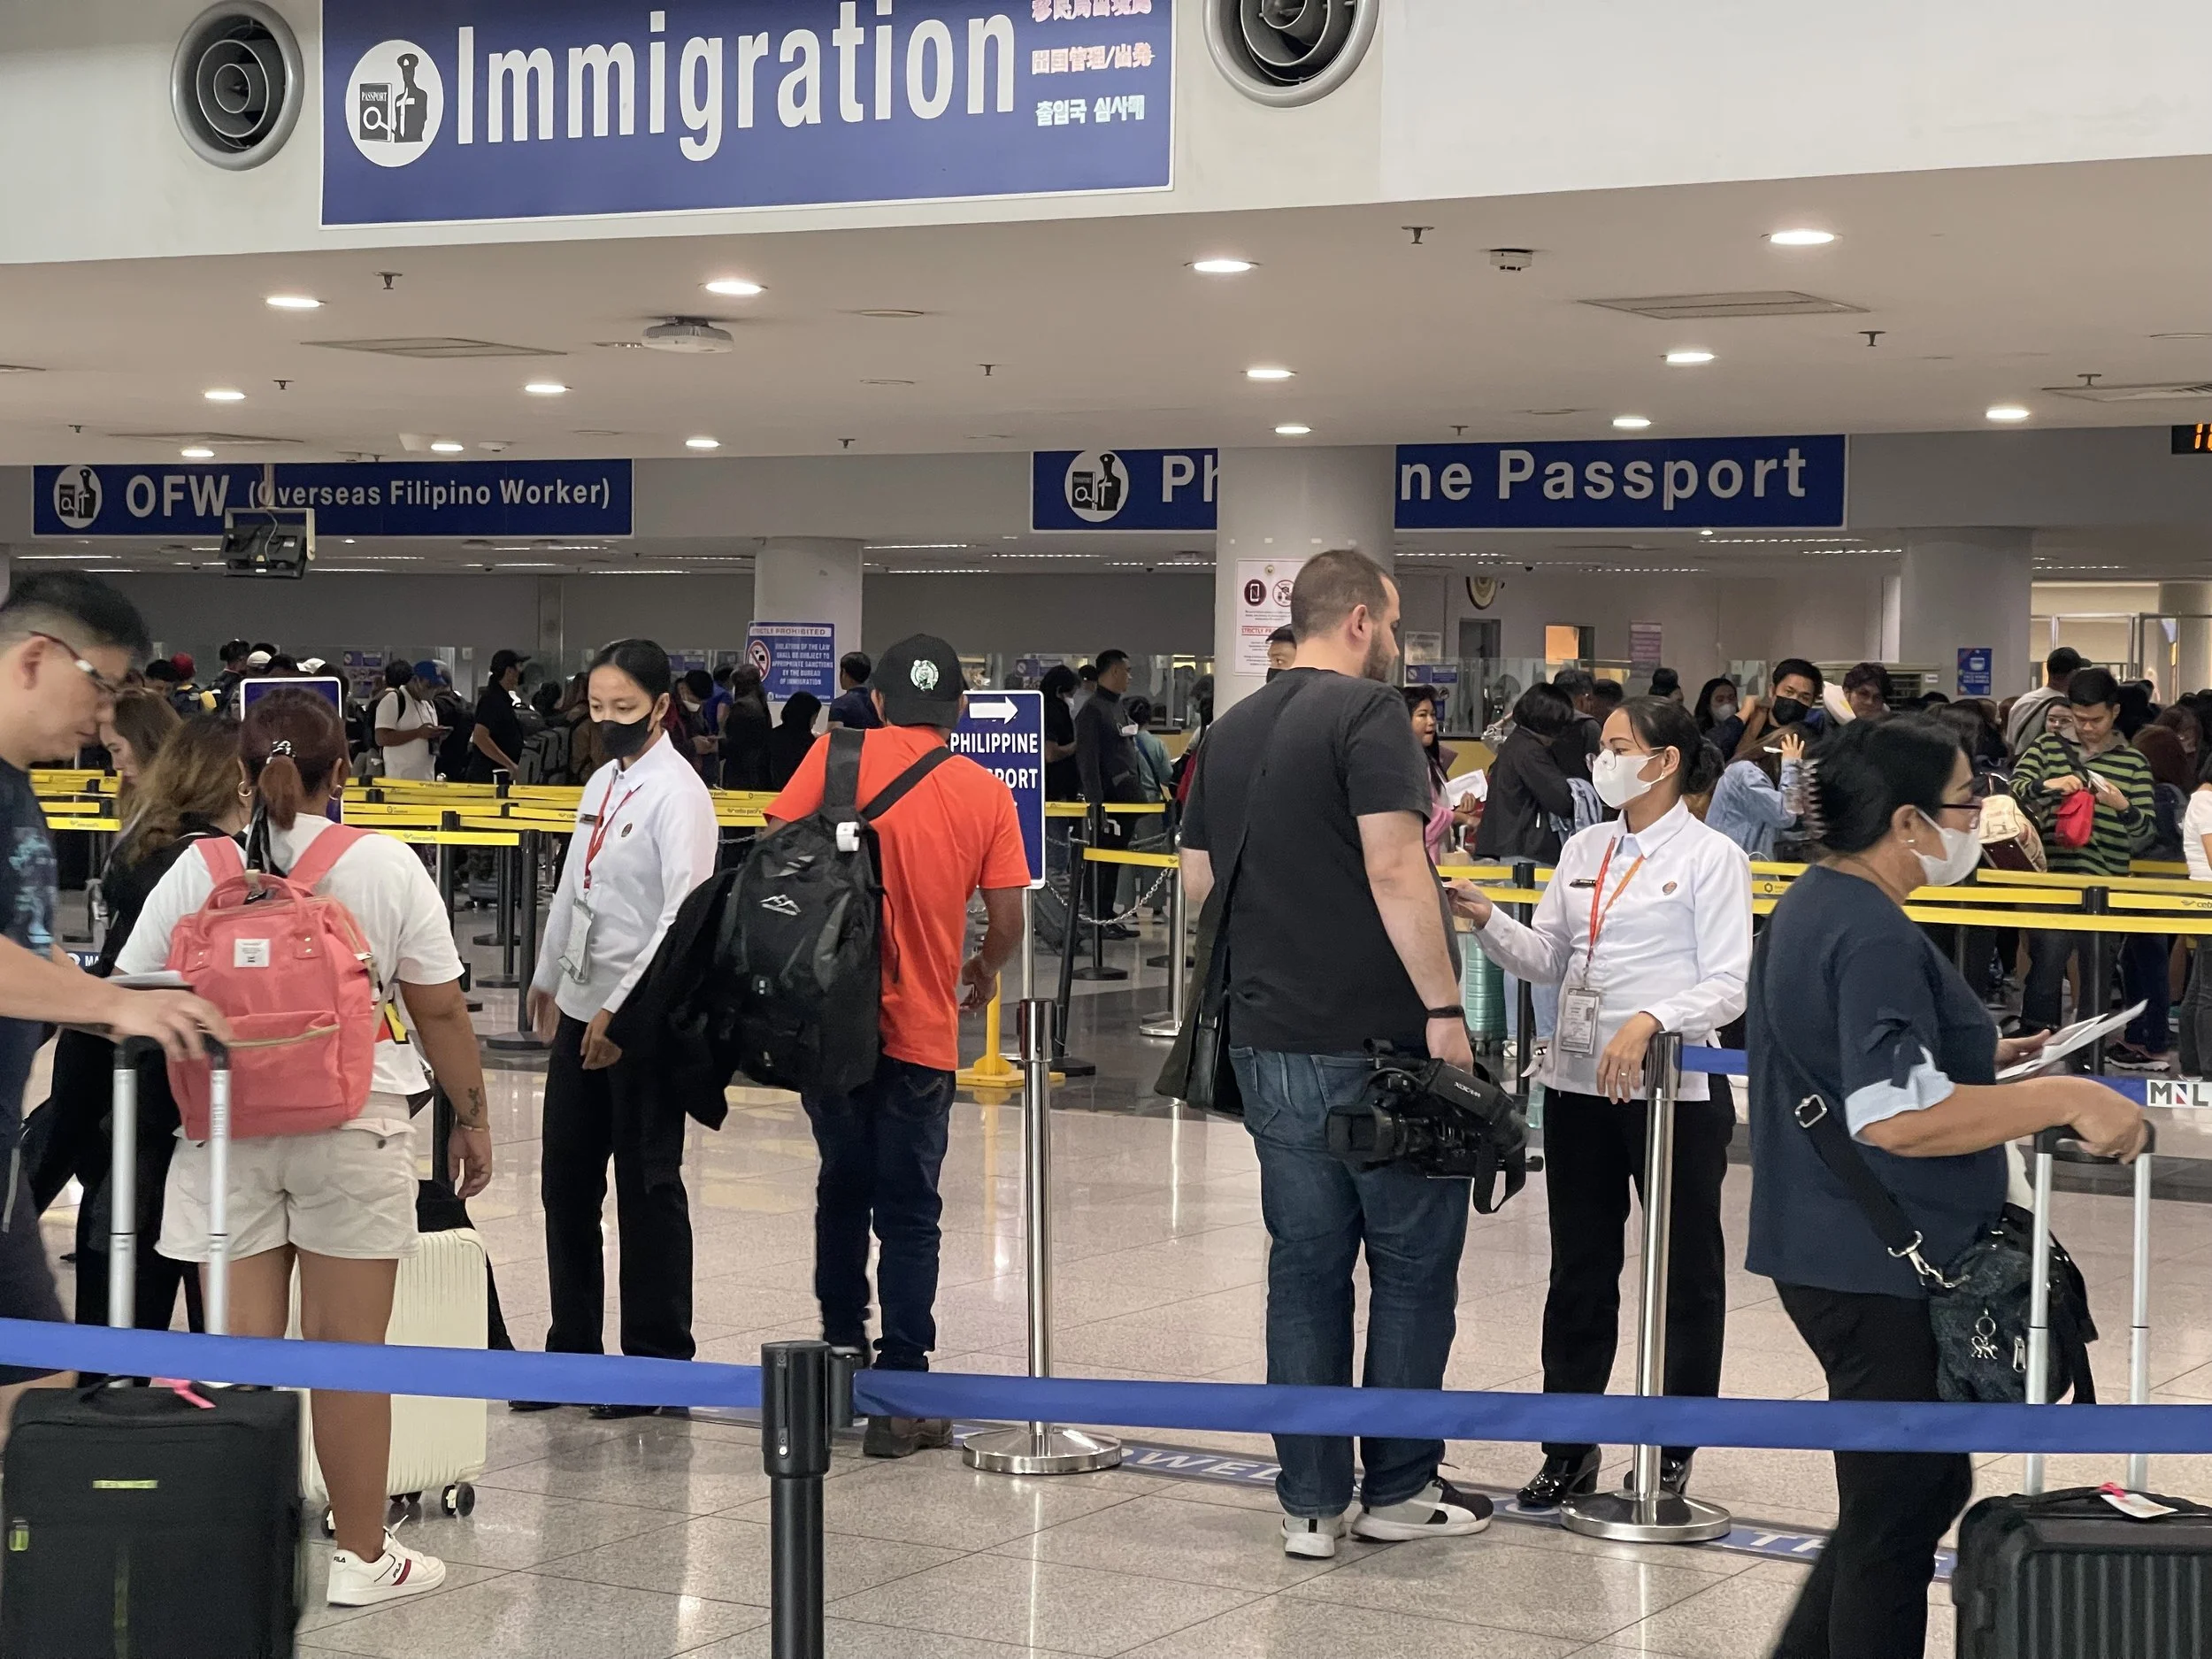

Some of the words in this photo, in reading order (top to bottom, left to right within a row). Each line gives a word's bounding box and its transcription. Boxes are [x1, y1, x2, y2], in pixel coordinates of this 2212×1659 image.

[458, 0, 1014, 162] Immigration
[361, 91, 388, 102] PASSPORT
[1035, 99, 1087, 127] 출입국
[1498, 448, 1806, 511] Passport
[126, 474, 230, 518] OFW
[390, 480, 491, 511] Filipino
[499, 478, 610, 510] Worker)
[950, 733, 1039, 754] PHILIPPINE
[2150, 1082, 2209, 1107] MNL
